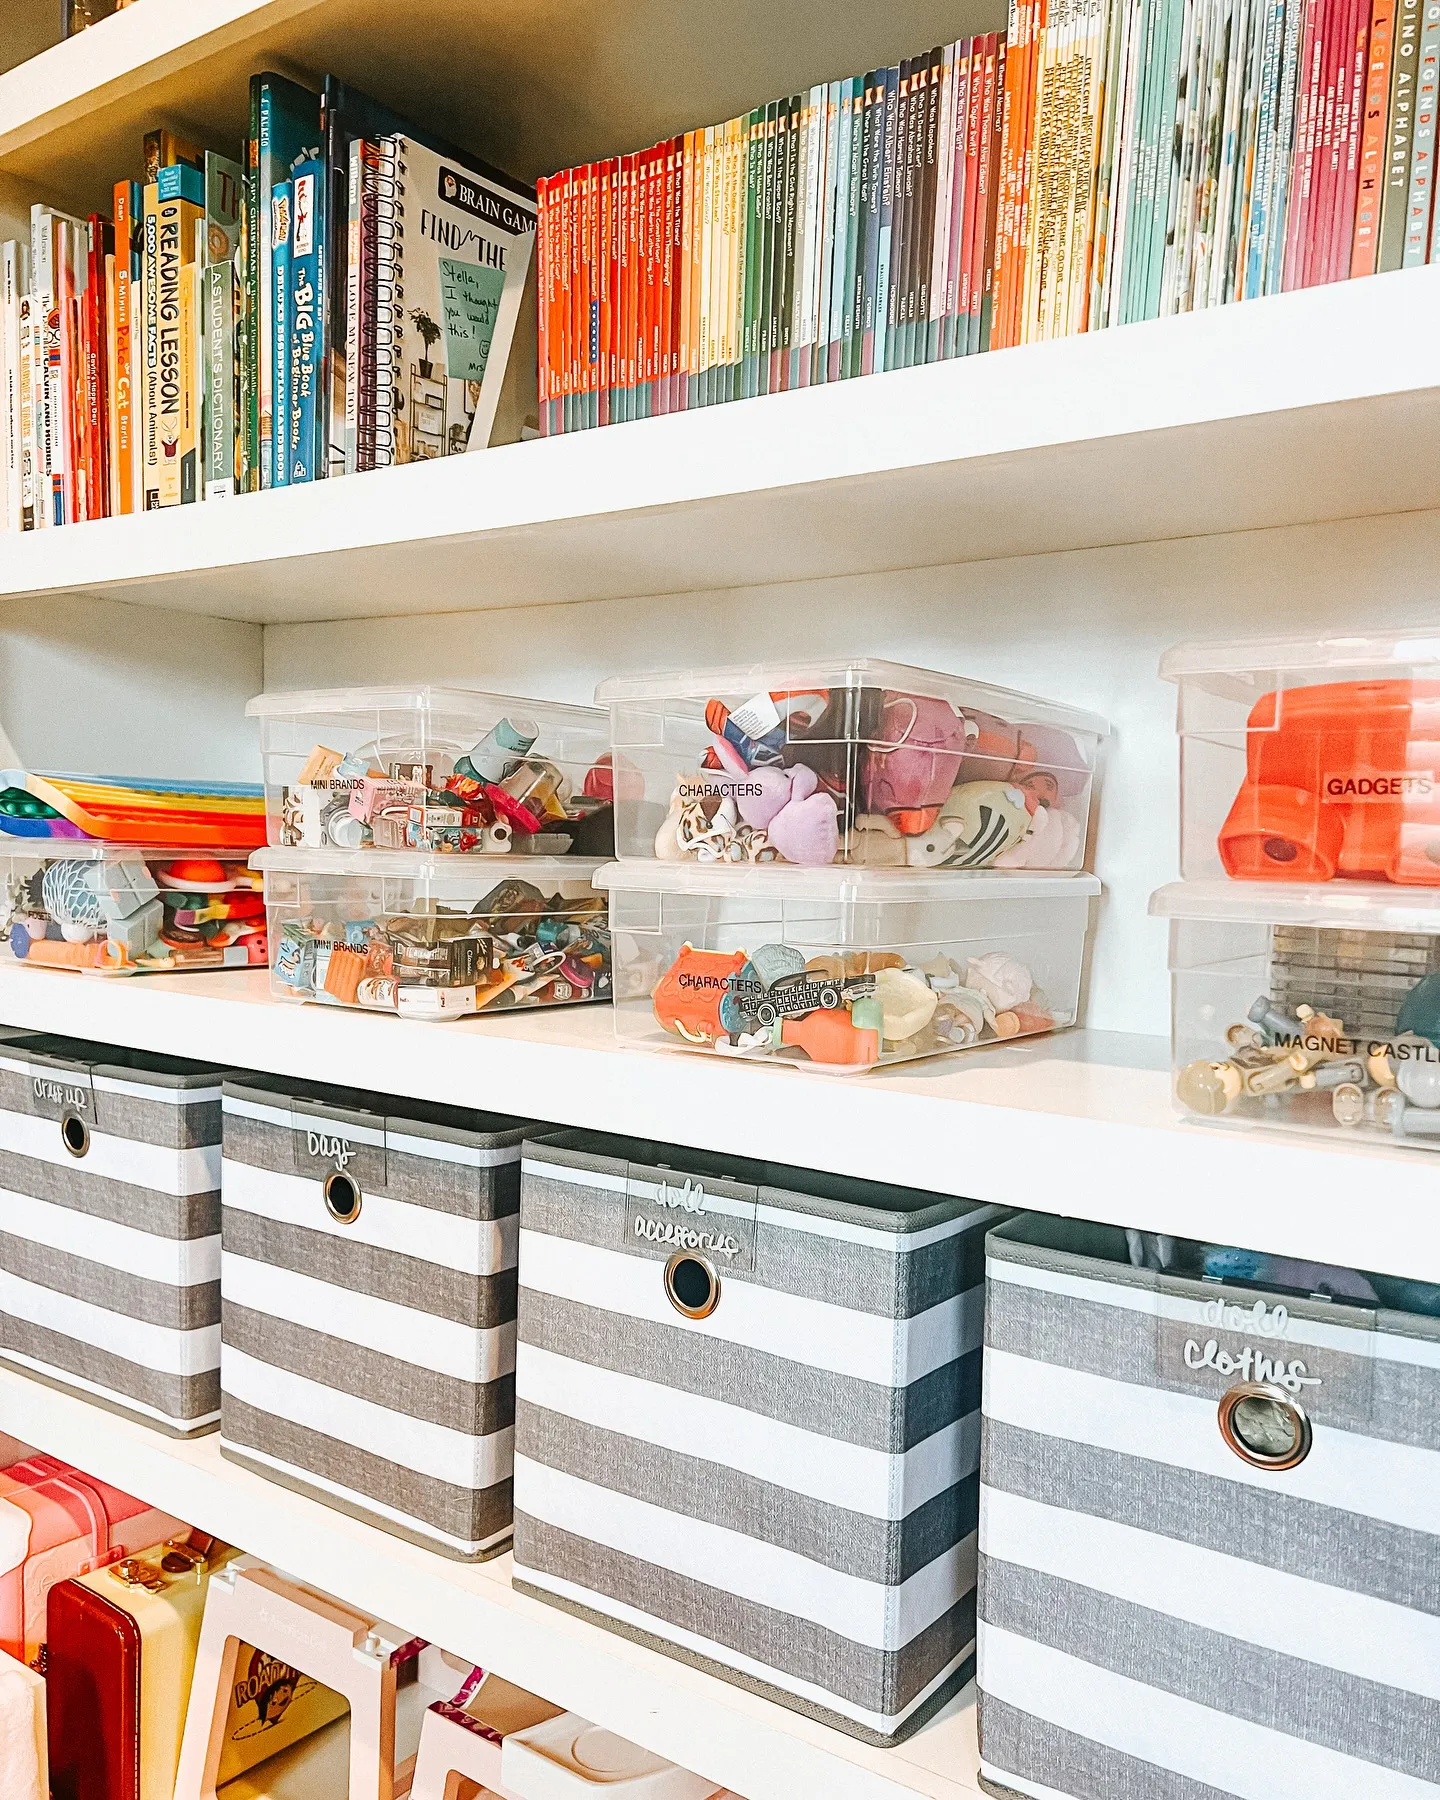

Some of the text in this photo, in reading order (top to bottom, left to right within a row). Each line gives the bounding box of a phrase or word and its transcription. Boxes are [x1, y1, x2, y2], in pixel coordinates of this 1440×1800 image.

[1266, 26, 1274, 40] THE
[1354, 51, 1363, 72] POPPY
[971, 76, 980, 94] Who
[1262, 75, 1271, 95] TRIP
[1353, 74, 1362, 87] AND
[261, 85, 269, 147] R. J. PALACIO
[969, 104, 979, 129] Taylor
[1261, 100, 1269, 111] TO
[979, 78, 992, 194] Who Was Thomas Alva Edison?
[1259, 114, 1268, 131] THE
[1350, 121, 1358, 133] BIG
[1357, 18, 1388, 251] LEGENDS ALPHABET
[1390, 72, 1412, 187] ALPHABET
[882, 90, 896, 206] Who Was Albert Einstein?
[968, 130, 977, 157] Swift?
[1347, 134, 1358, 171] ADVENTURE
[1406, 44, 1437, 255] LEGENDS ALPHABET
[349, 155, 359, 205] Willems
[1254, 134, 1266, 201] SUPERMARKET
[460, 184, 537, 233] BRAIN GAM
[420, 208, 508, 272] FIND THE
[250, 279, 257, 287] A
[442, 262, 479, 288] Stella,
[118, 270, 128, 323] 5-Minute
[348, 286, 357, 322] LOVE
[444, 286, 498, 313] I thought
[445, 306, 460, 320] you
[160, 222, 180, 415] READING LESSON
[251, 316, 257, 327] of
[294, 267, 314, 398] The BIG Blue Book
[117, 325, 130, 365] Pete
[146, 215, 159, 466] 5,000 AWESOME FACTS (About Animals!)
[348, 326, 356, 347] MY
[212, 272, 224, 472] A STUDENT'S DICTIONARY
[276, 266, 285, 482] DELUXE ESSENTIAL HANDBOOK
[347, 352, 356, 384] NEW
[117, 377, 130, 410] Cat
[291, 333, 302, 451] of Beginner Books
[346, 388, 356, 422] TOY!
[91, 407, 99, 426] Day!
[310, 779, 364, 790] MINI BRANDS
[678, 784, 762, 797] CHARACTERS
[1327, 778, 1432, 796] GADGETS
[314, 940, 368, 954] MINI BRANDS
[678, 974, 762, 993] CHARACTERS
[1274, 1032, 1360, 1055] MAGNET
[307, 1130, 356, 1172] bags
[656, 1178, 706, 1216] doll
[1202, 1298, 1290, 1339] doll
